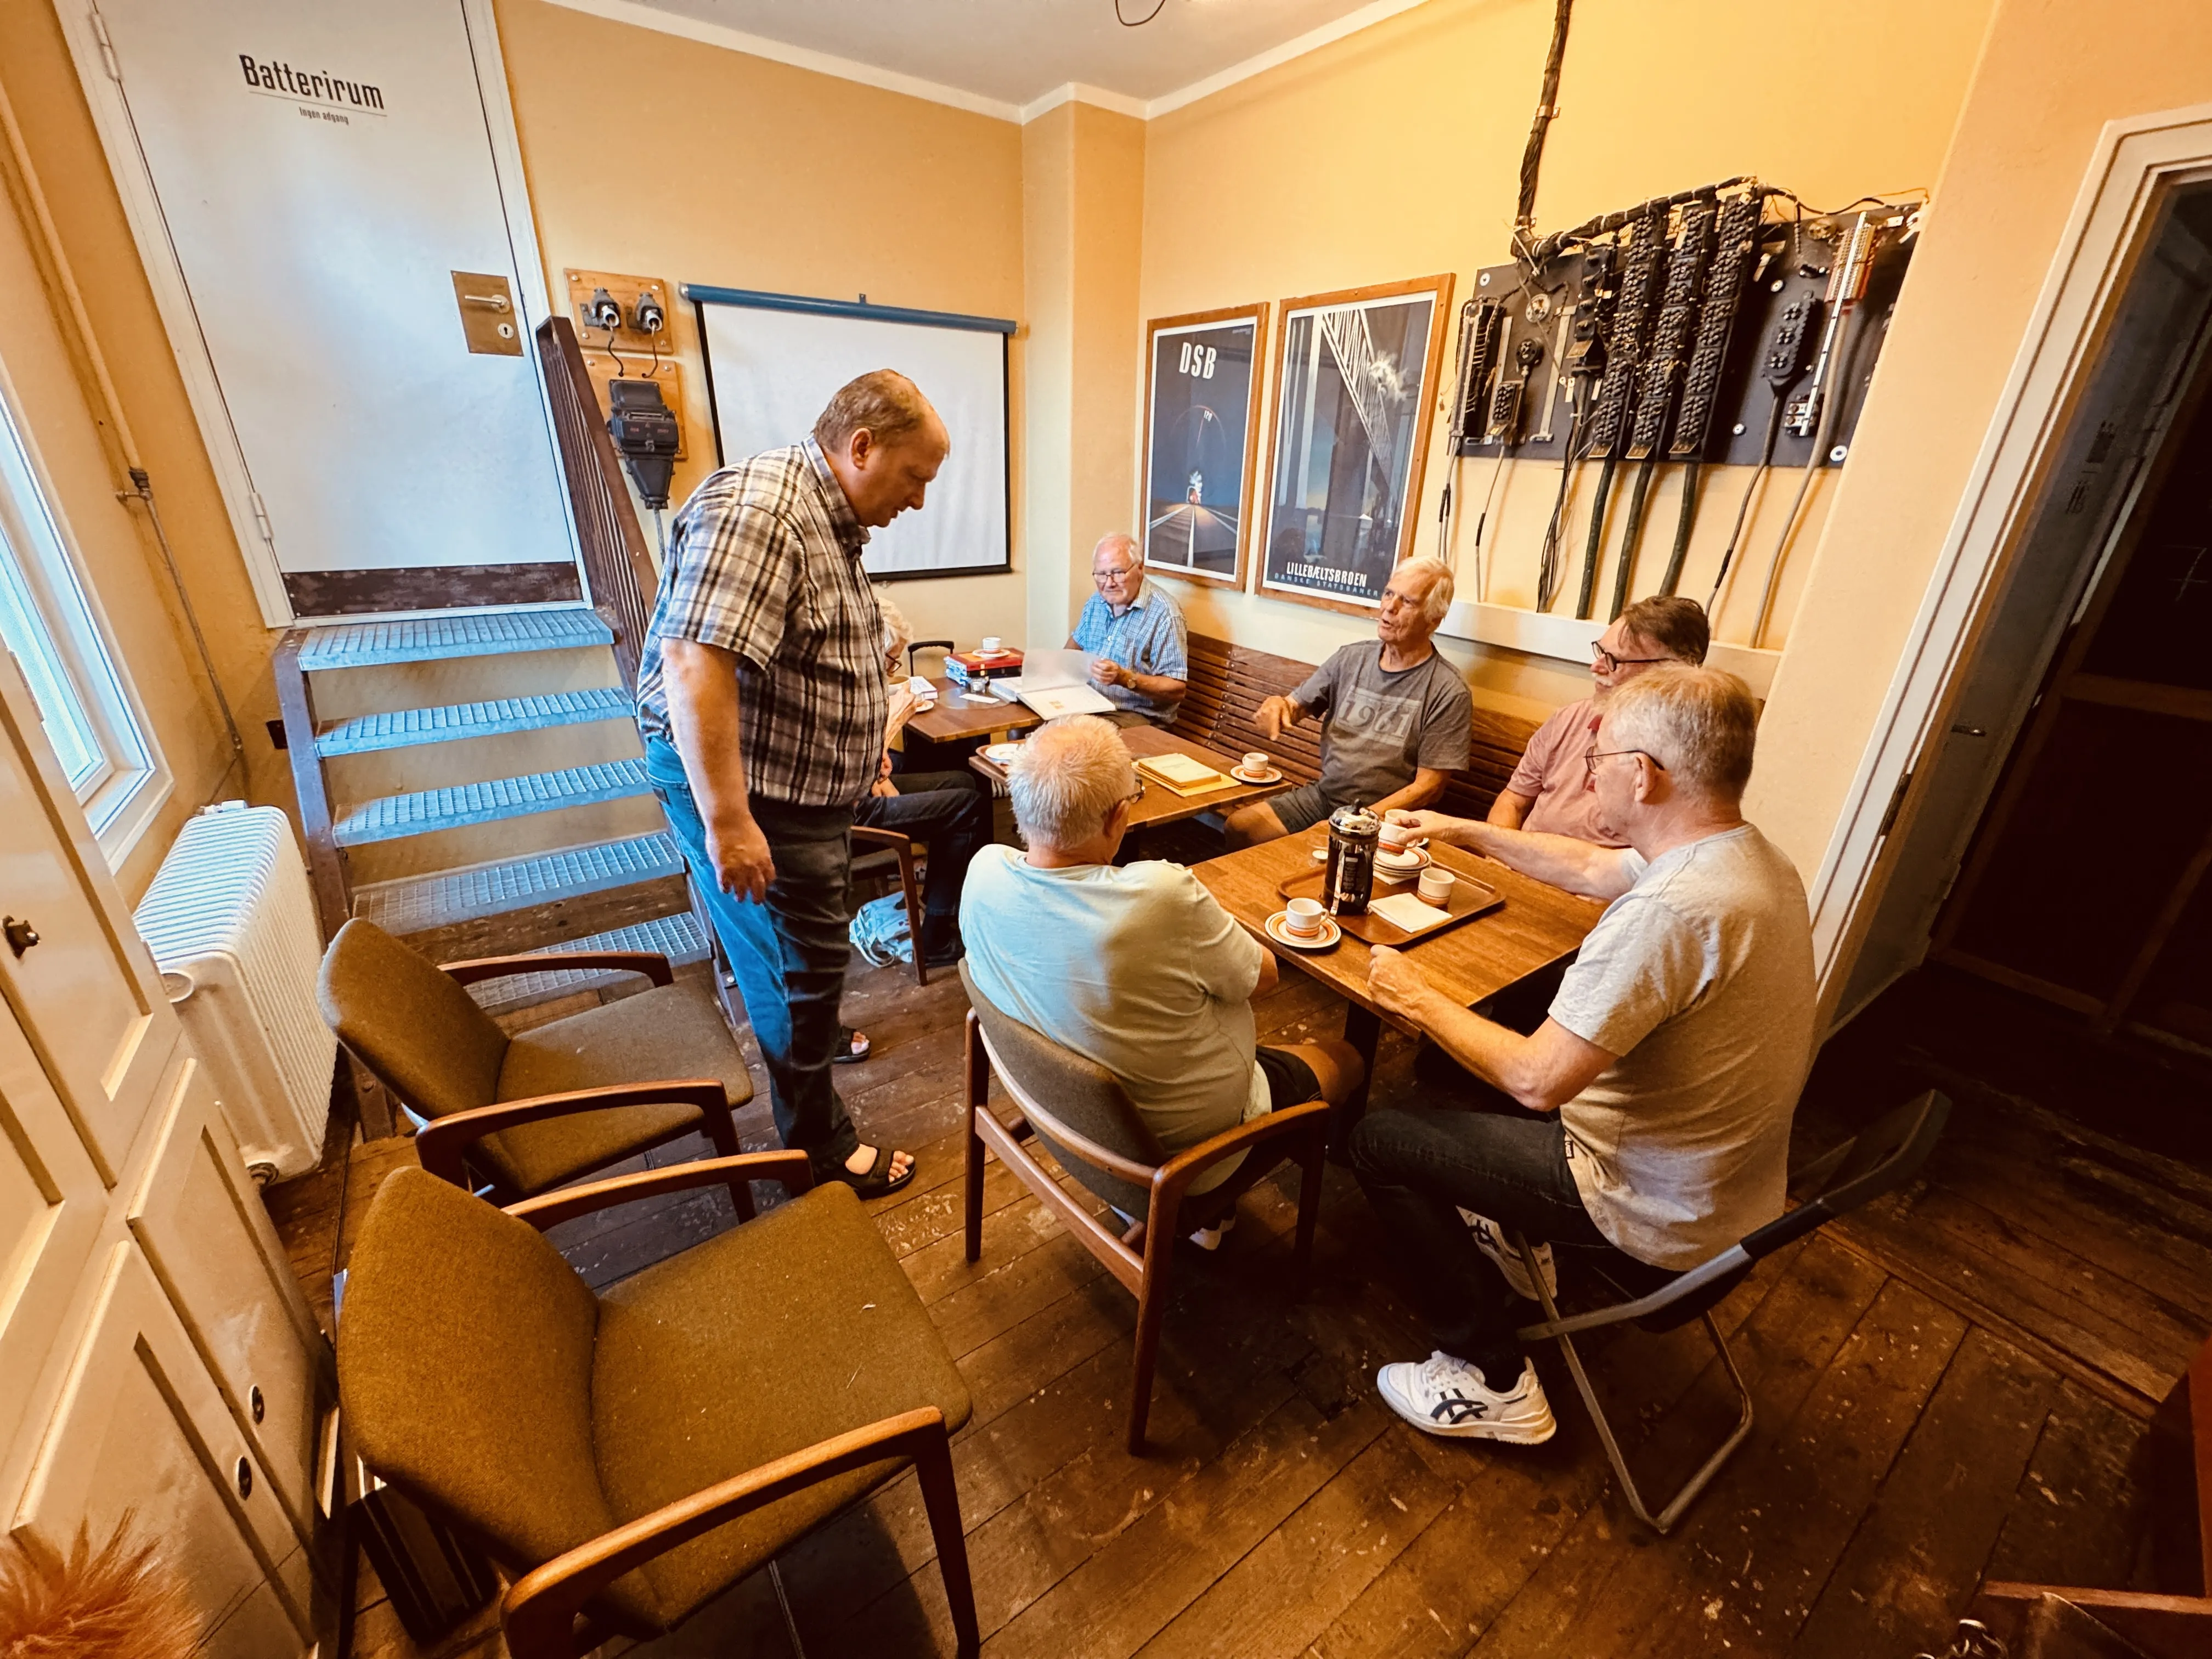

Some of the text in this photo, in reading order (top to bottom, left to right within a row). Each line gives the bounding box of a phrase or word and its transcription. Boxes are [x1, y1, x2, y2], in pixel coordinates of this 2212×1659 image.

[239, 54, 385, 110] Batterirum
[299, 106, 349, 125] Ingen adgang
[1179, 342, 1217, 380] DSB
[1274, 573, 1378, 597] DANSKE STATSBANER
[1286, 562, 1368, 588] LILLEBÆLTSBROEN
[1339, 700, 1410, 738] 1961
